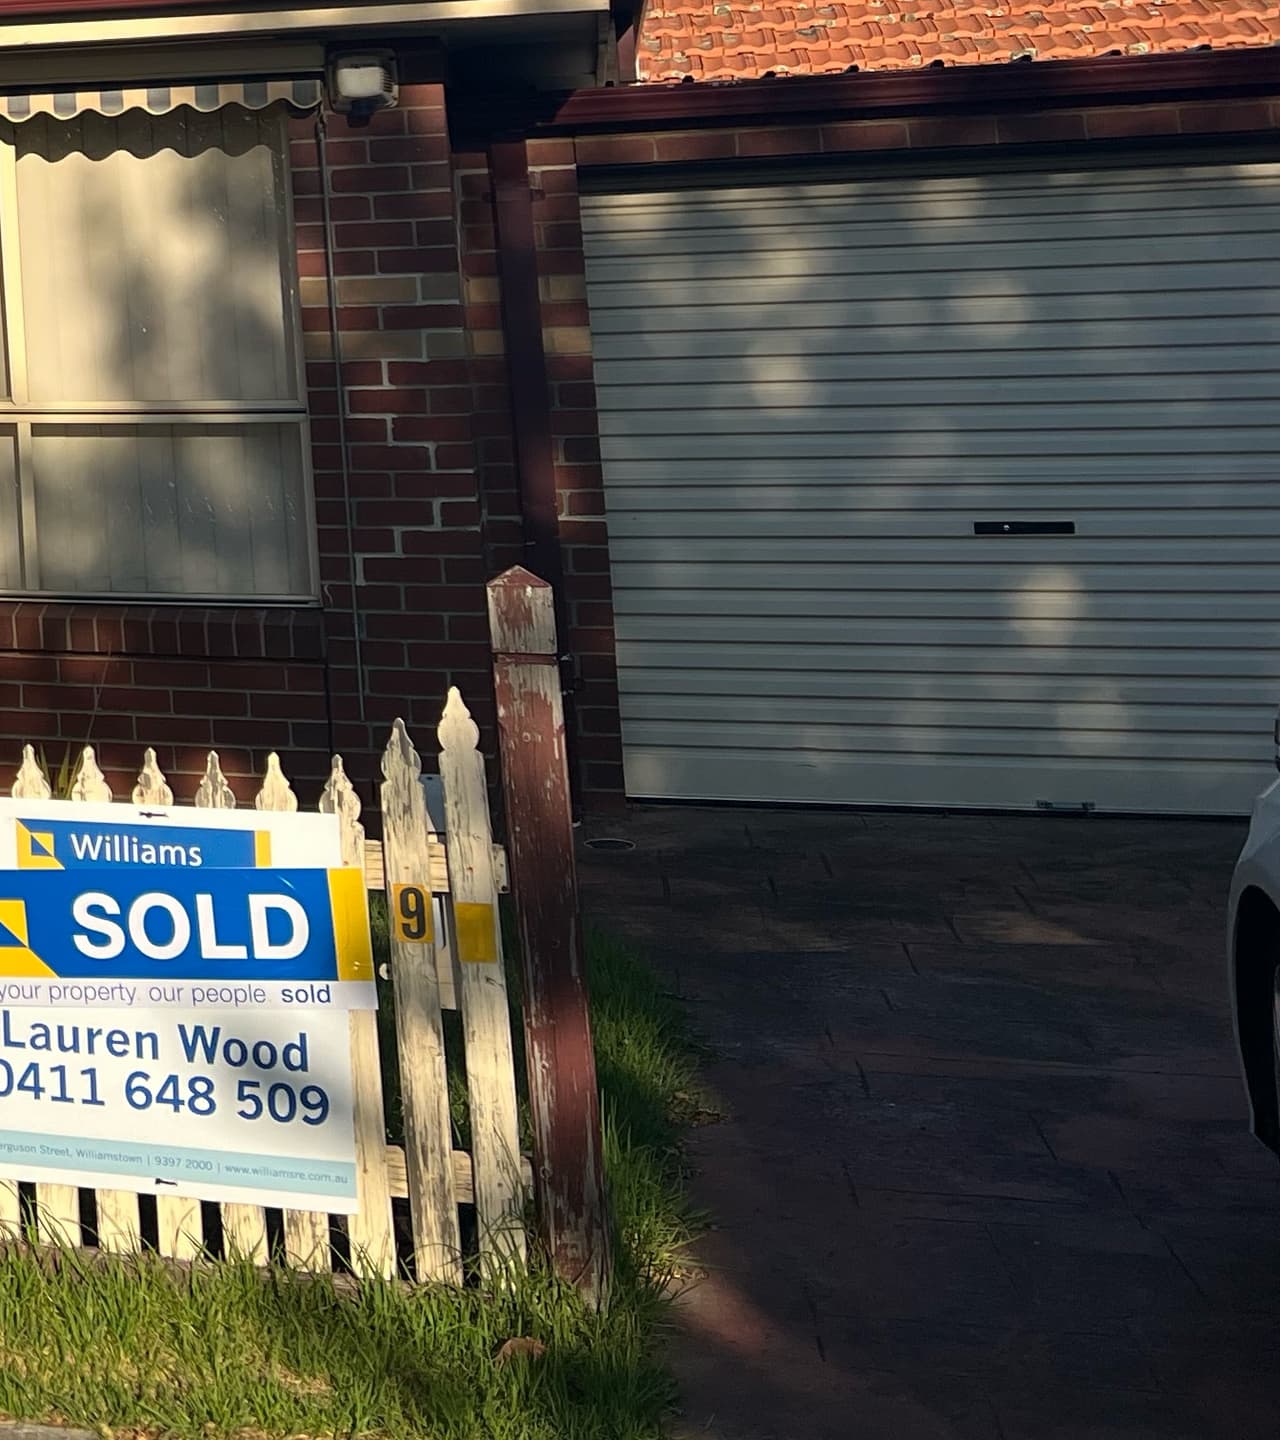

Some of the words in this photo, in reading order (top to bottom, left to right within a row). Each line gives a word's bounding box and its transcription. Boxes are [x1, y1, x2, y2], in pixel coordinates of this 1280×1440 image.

[71, 833, 202, 866] Williams
[72, 892, 309, 960] SOLD
[400, 887, 426, 939] 9
[148, 985, 184, 1002] our
[281, 984, 331, 1003] sold
[2, 1009, 159, 1060] Lauren
[177, 1023, 309, 1073] Wood
[125, 1072, 217, 1116] 648
[237, 1080, 330, 1126] 509
[75, 1148, 143, 1164] Williamstown
[154, 1156, 181, 1168] 9397
[185, 1159, 212, 1172] 2000
